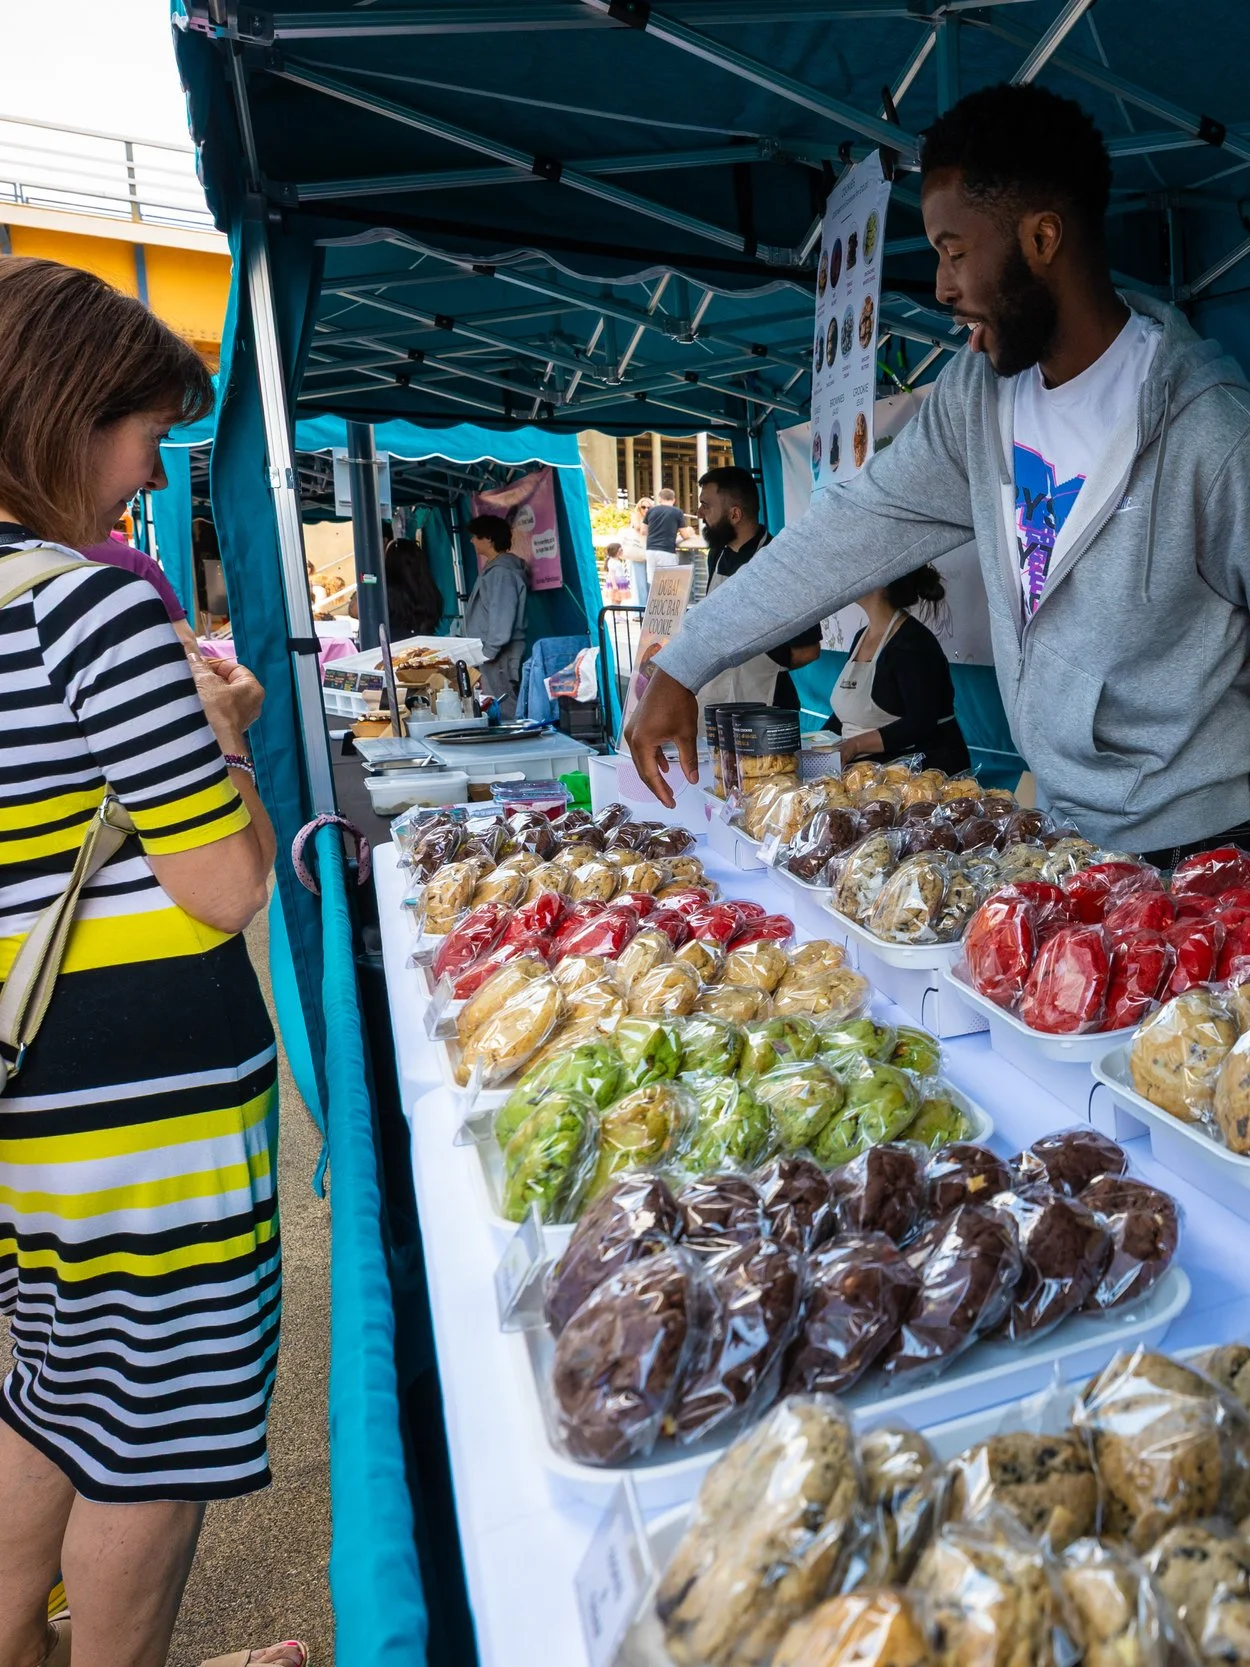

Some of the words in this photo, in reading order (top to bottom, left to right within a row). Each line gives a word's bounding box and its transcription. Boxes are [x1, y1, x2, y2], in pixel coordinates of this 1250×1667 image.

[657, 578, 681, 597] DUBAI
[648, 598, 668, 616] CHOC
[667, 598, 681, 617] BAR
[648, 617, 674, 636] COOKIE
